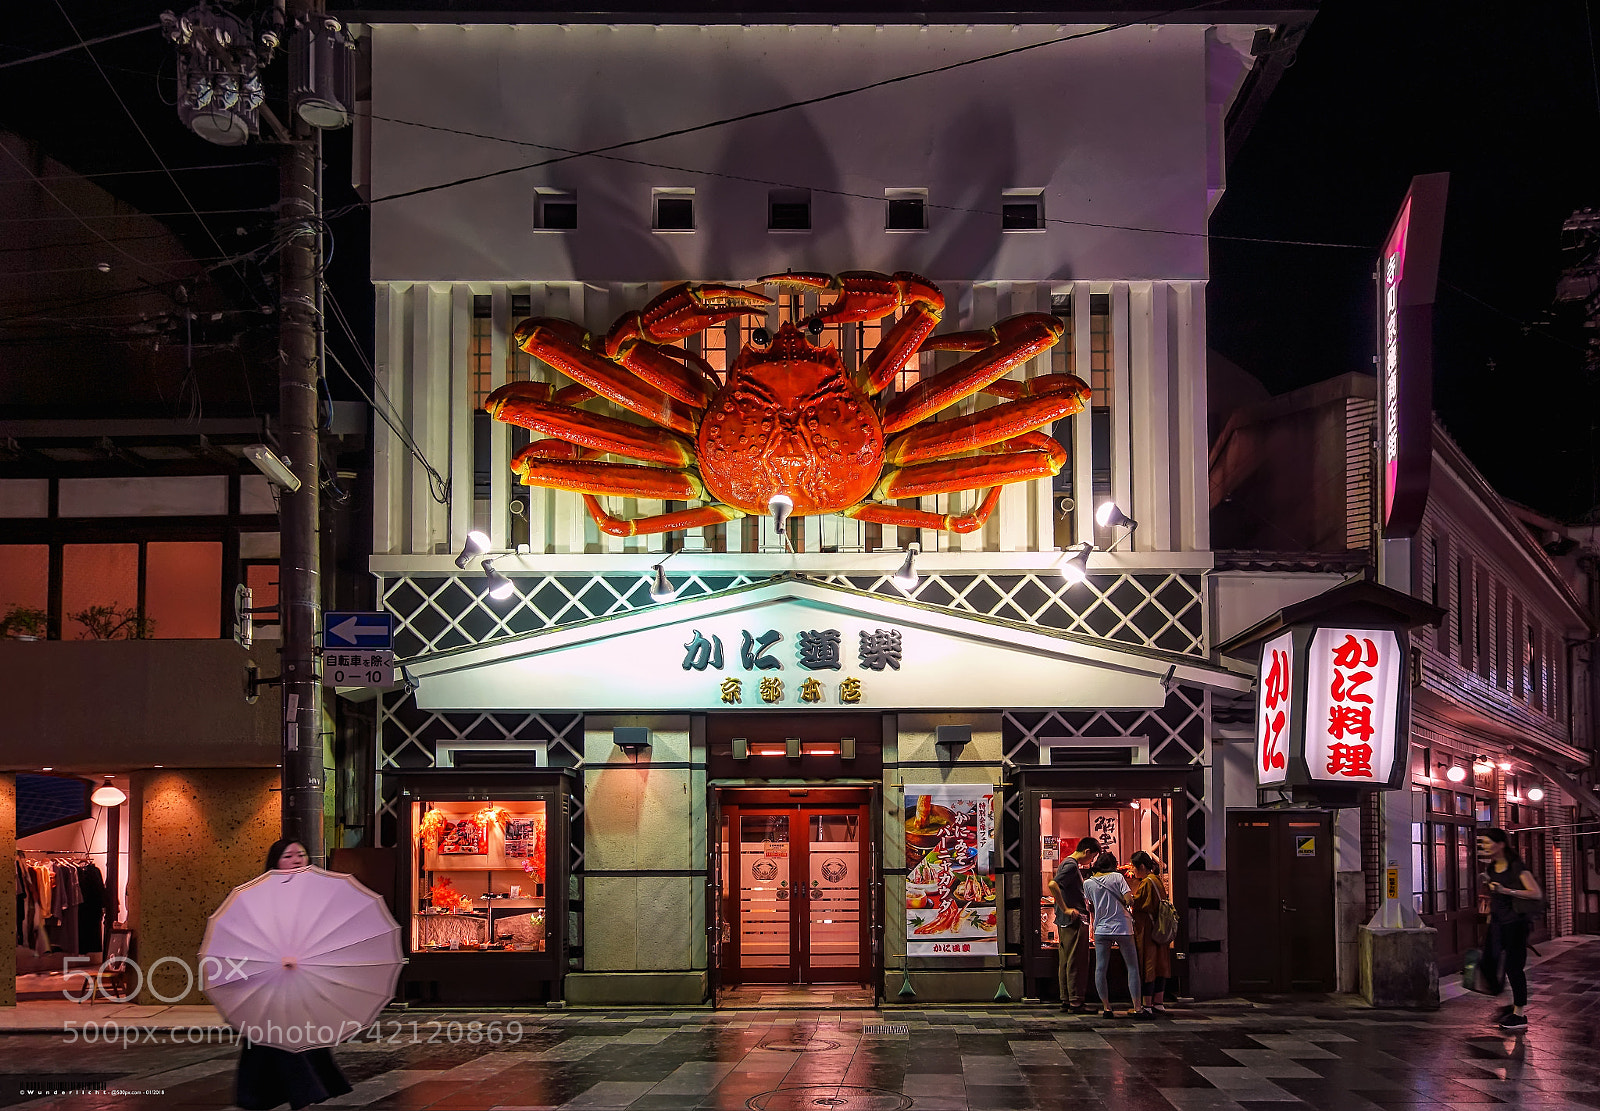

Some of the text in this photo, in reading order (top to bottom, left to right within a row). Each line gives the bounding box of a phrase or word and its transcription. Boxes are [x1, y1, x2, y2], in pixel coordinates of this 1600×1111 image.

[327, 655, 391, 667] 自転車を除く
[682, 629, 902, 671] かに道楽
[720, 677, 861, 704] 京都本店
[1263, 650, 1289, 771] かに
[1327, 635, 1379, 777] かに料理
[954, 812, 970, 866] かにみそ
[937, 824, 951, 914] バーニャカウダ
